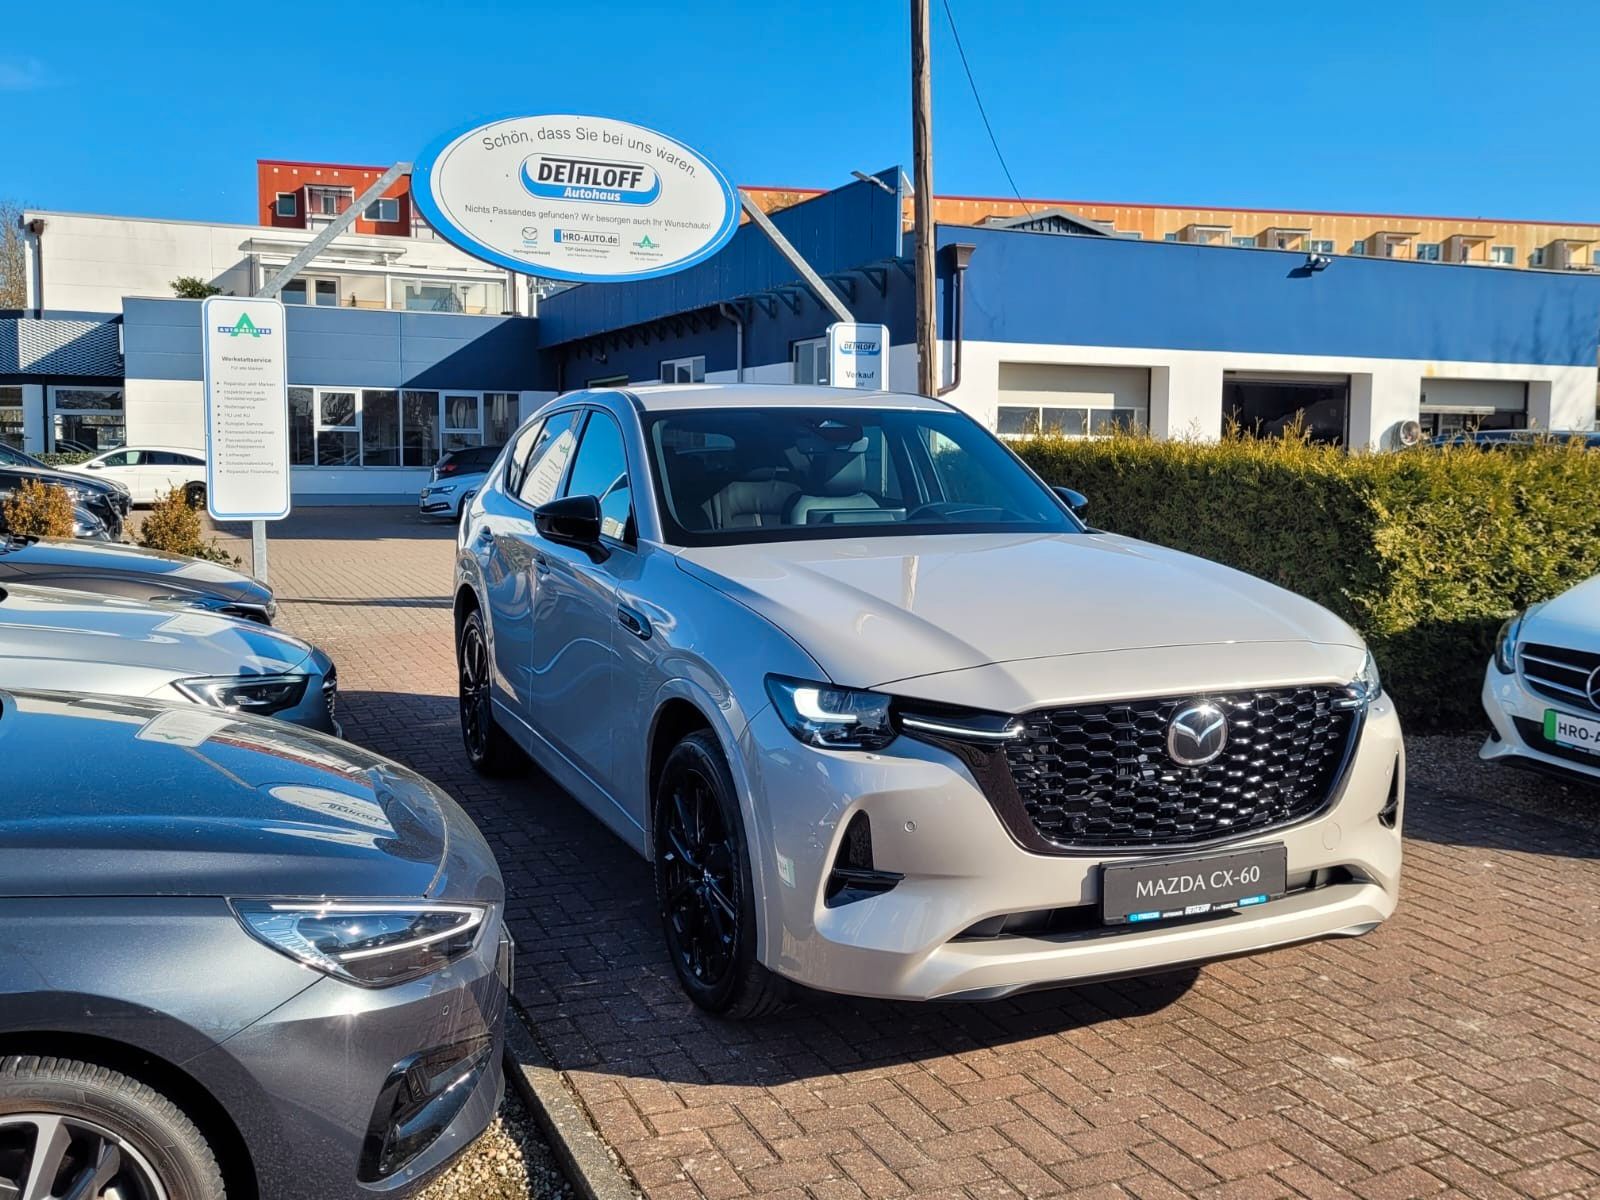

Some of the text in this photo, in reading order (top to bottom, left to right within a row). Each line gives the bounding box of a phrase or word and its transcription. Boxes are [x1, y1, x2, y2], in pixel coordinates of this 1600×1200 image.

[482, 127, 696, 178] Schön, dass Sie bei uns waren.
[538, 157, 645, 188] DETHLOFF
[563, 187, 621, 201] Autohaus
[465, 204, 711, 230] Nichts Passendes gefunden? Wir besorgen auch Ihr Wunschauto!
[562, 232, 618, 244] HRO-AUTO.de
[845, 370, 875, 379] Verkauf
[1136, 865, 1260, 898] MAZDA CX-60
